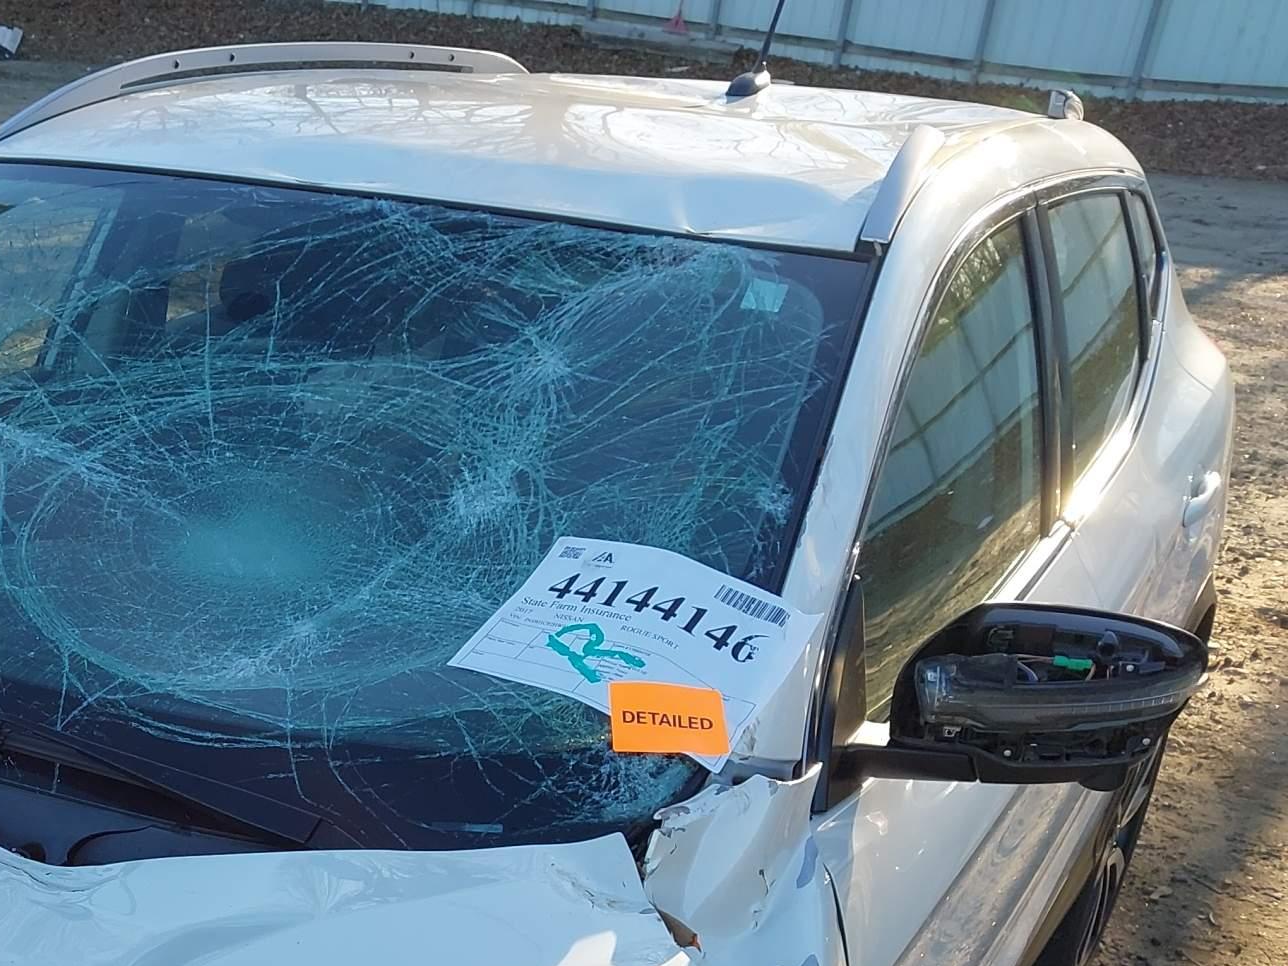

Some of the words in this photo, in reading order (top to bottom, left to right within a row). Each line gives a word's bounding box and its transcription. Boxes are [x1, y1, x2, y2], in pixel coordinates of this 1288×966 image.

[521, 596, 548, 608] State
[550, 599, 578, 612] Farm
[580, 603, 632, 622] Insurance
[548, 572, 770, 663] 44144146
[554, 613, 584, 623] NISSAN
[620, 624, 651, 638] ROGUE
[651, 634, 679, 649] SPORT
[622, 710, 713, 730] DETAILED
